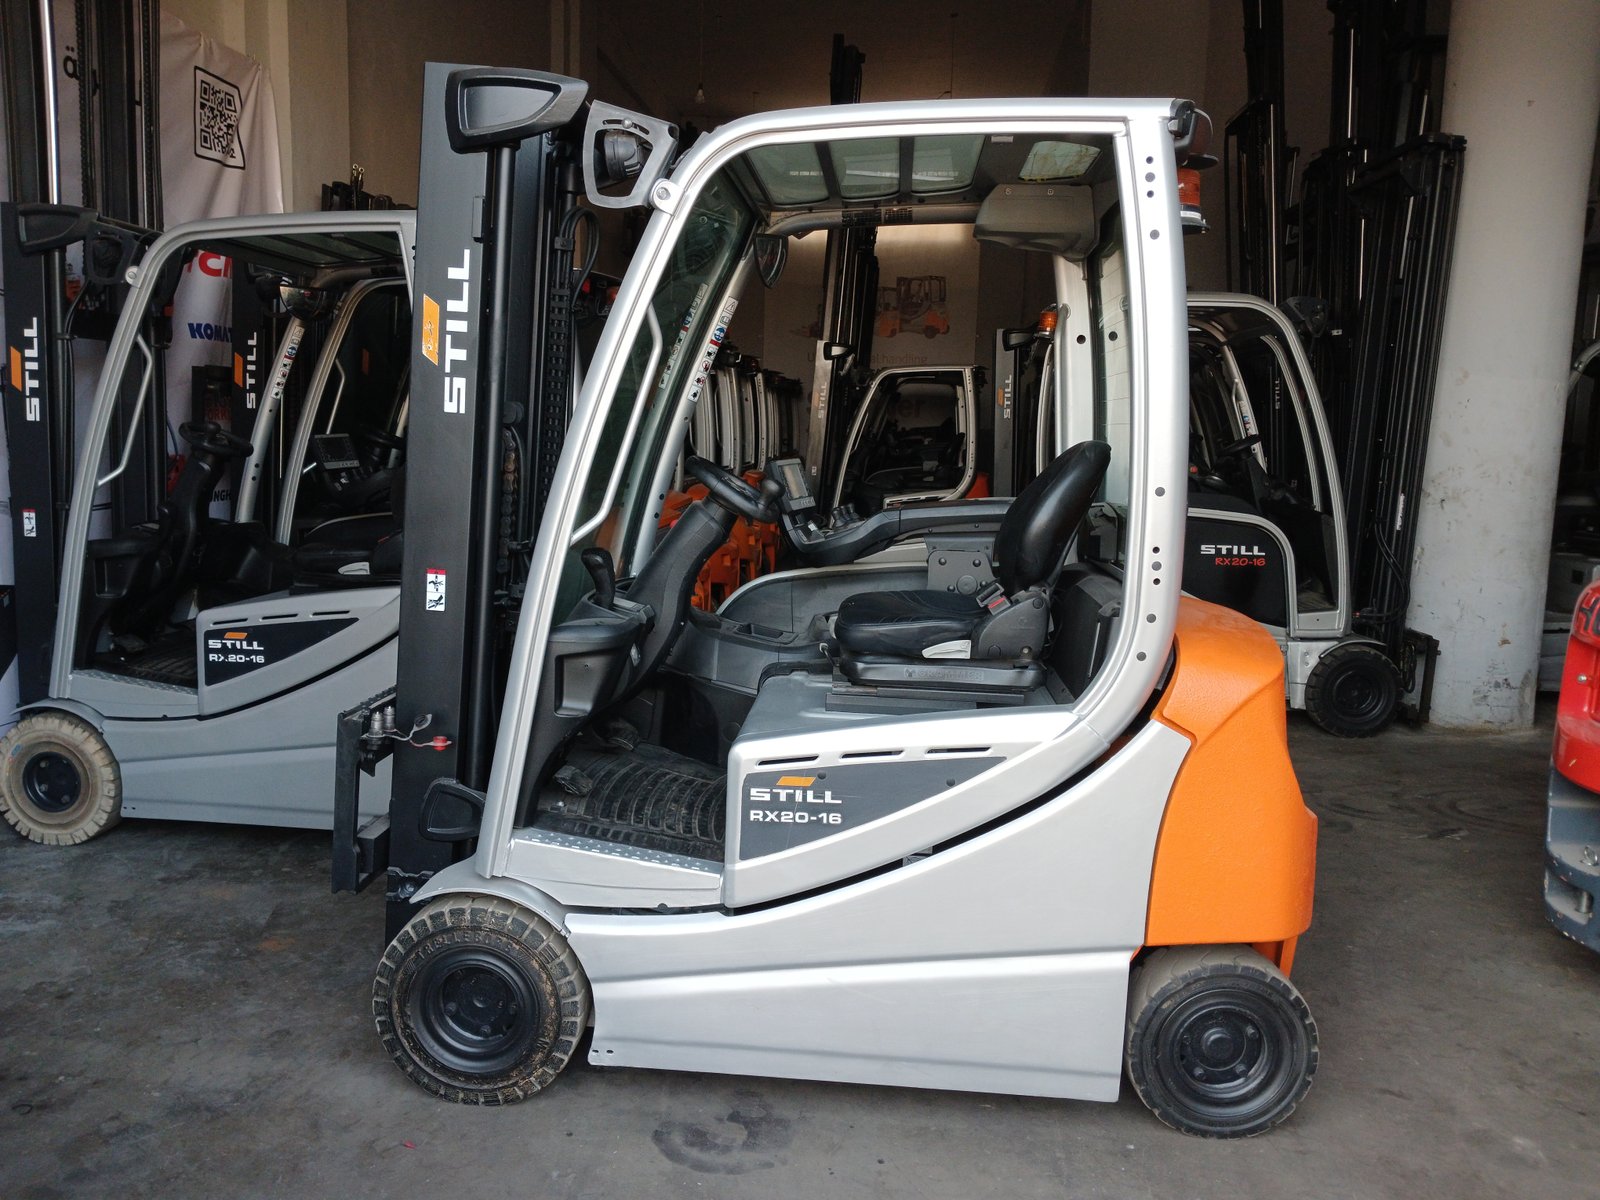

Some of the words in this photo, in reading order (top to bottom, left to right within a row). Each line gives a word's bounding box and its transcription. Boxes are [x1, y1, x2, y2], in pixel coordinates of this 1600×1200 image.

[443, 249, 471, 414] STILL
[23, 317, 40, 422] STILL
[246, 332, 257, 409] STILL
[817, 381, 828, 420] STILL
[1003, 374, 1012, 419] STILL
[1200, 544, 1266, 556] STILL
[1215, 557, 1266, 567] RX20-16
[208, 640, 264, 651] STILL
[750, 787, 842, 804] STILL
[749, 810, 842, 825] RX20-16
